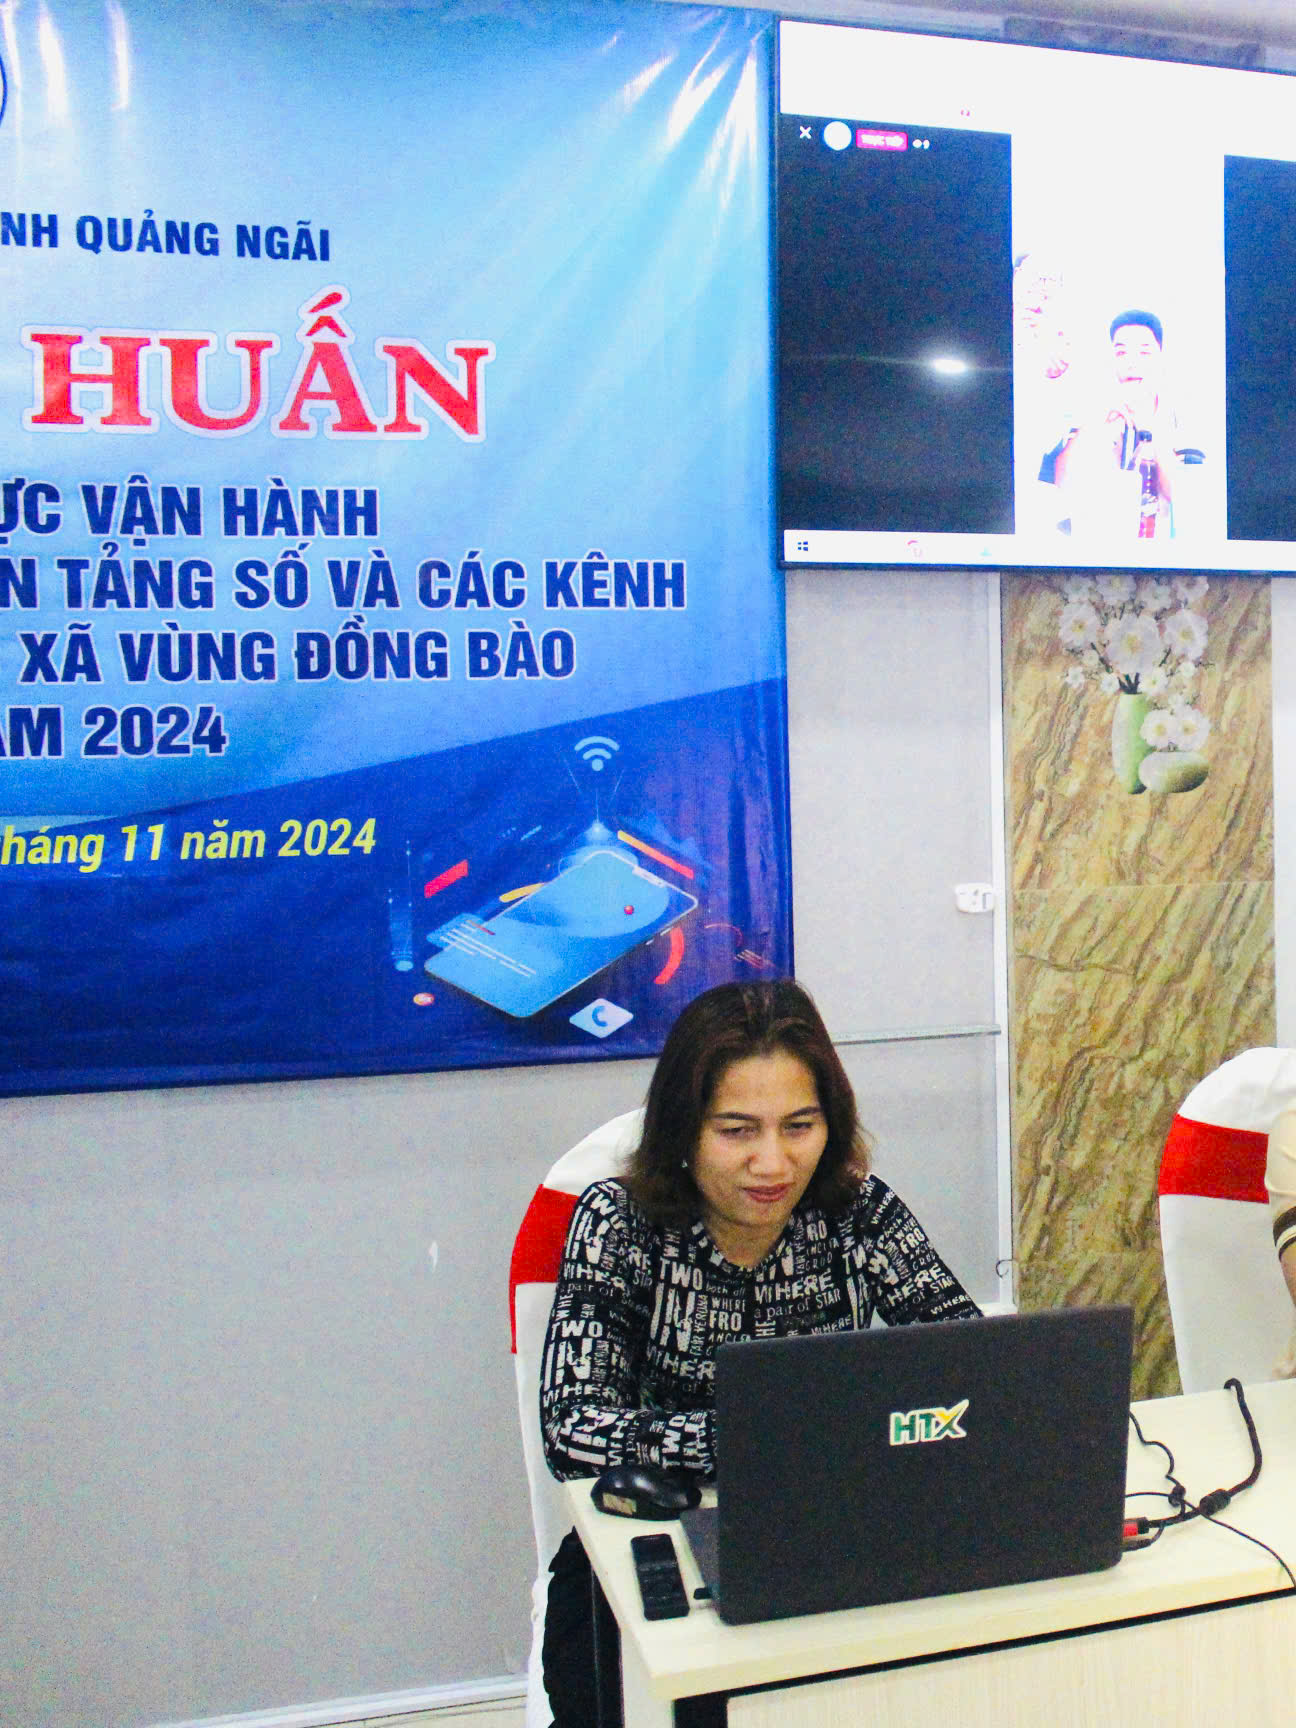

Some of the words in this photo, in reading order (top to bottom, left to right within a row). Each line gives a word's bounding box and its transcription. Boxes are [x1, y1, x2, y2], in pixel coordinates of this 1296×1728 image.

[0, 211, 58, 248] NH
[75, 209, 220, 257] QUẢNG
[235, 220, 331, 262] NGÃI
[29, 291, 490, 436] HUẤN
[81, 475, 202, 547] VẬN
[222, 478, 379, 537] HÀNH
[56, 541, 217, 610] TẢNG
[234, 543, 310, 610] SỐ
[328, 551, 400, 609] VÀ
[418, 551, 526, 609] CÁC
[545, 551, 687, 609] KÊNH
[19, 622, 102, 683] XÃ
[119, 622, 275, 682] VÙNG
[295, 612, 449, 681] ĐỒNG
[468, 622, 575, 679] BÀO
[0, 706, 63, 757] M
[83, 705, 227, 757] 2024
[0, 825, 105, 873] háng
[120, 824, 163, 863] 11
[180, 820, 266, 861] năm
[278, 818, 377, 858] 2024
[660, 1256, 703, 1291] TWO
[754, 1267, 835, 1305] WHERE
[551, 1320, 603, 1338] TWO
[709, 1310, 743, 1332] FRO
[767, 1303, 794, 1321] pair
[815, 1287, 842, 1310] STAR
[889, 1398, 970, 1447] HTX
